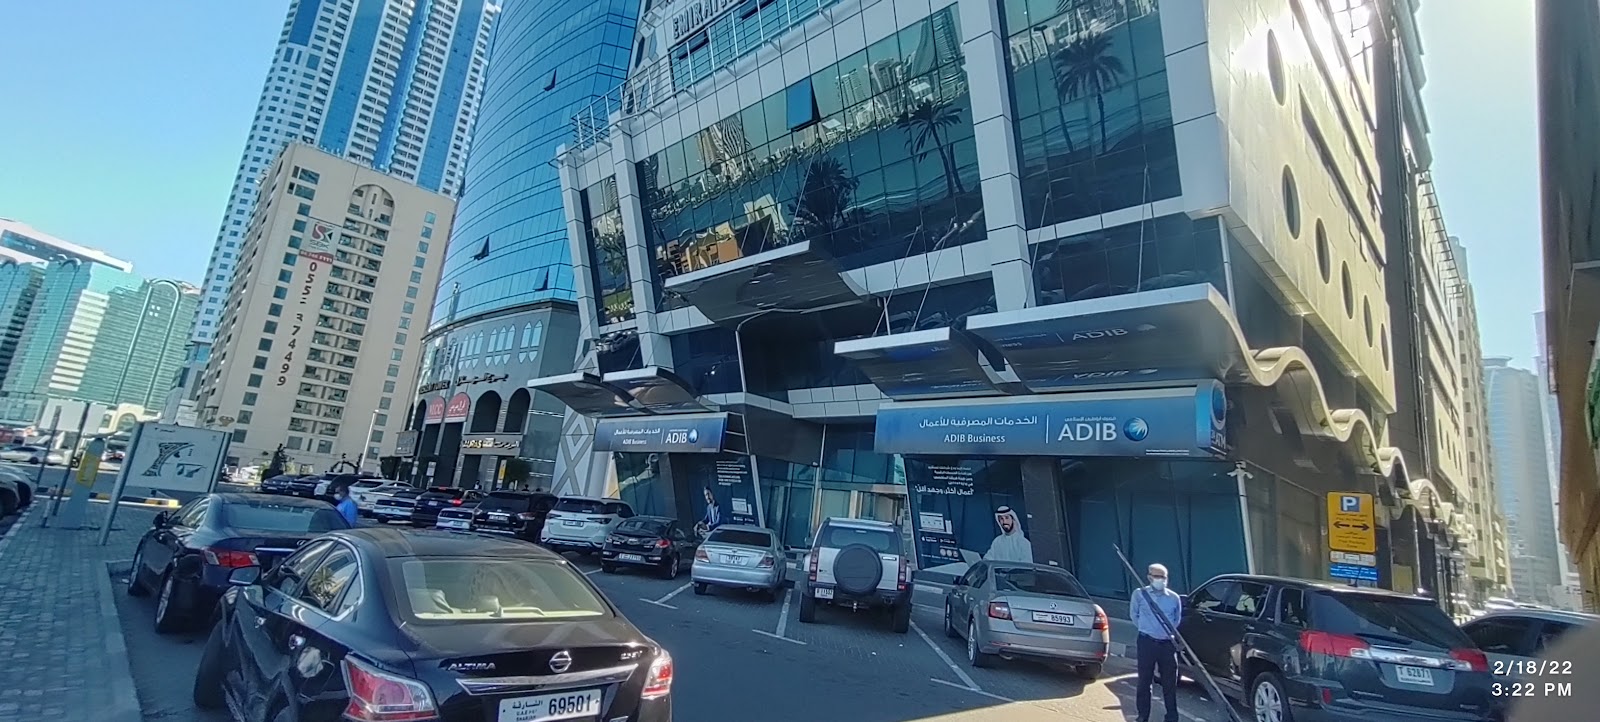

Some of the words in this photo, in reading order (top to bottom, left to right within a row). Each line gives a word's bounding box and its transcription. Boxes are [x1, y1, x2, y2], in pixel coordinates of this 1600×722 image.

[1073, 329, 1128, 340] ADIB
[919, 416, 950, 428] للأعمال
[950, 417, 993, 428] المصرفية
[994, 415, 1037, 426] الخدمات
[1057, 423, 1117, 441] ADIB
[665, 432, 687, 444] ADIB
[943, 434, 965, 443] ADIB
[967, 433, 1005, 443] Business
[1343, 496, 1357, 511] P
[448, 662, 496, 671] ALTIMA
[549, 694, 591, 715] 69501
